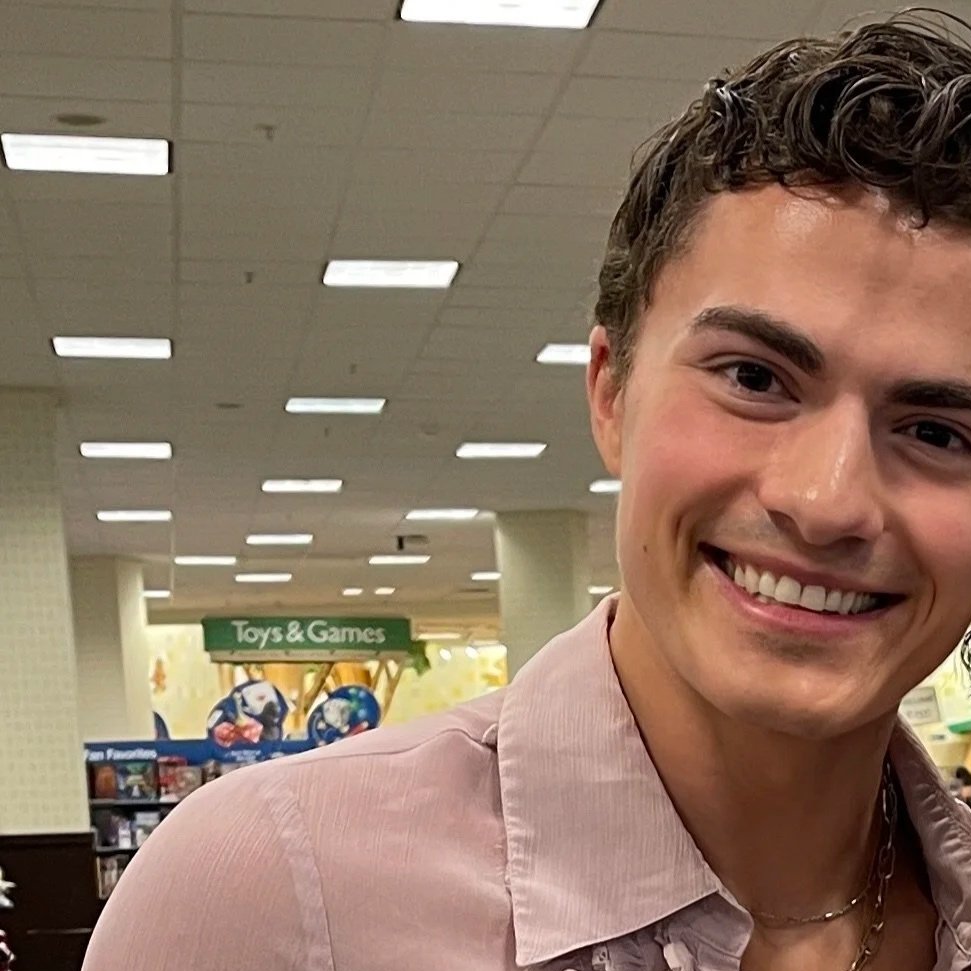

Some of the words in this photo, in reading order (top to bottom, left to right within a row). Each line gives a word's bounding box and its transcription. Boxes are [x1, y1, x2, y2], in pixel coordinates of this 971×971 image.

[230, 619, 283, 650] Toys
[285, 619, 305, 643] &
[307, 619, 386, 644] Games
